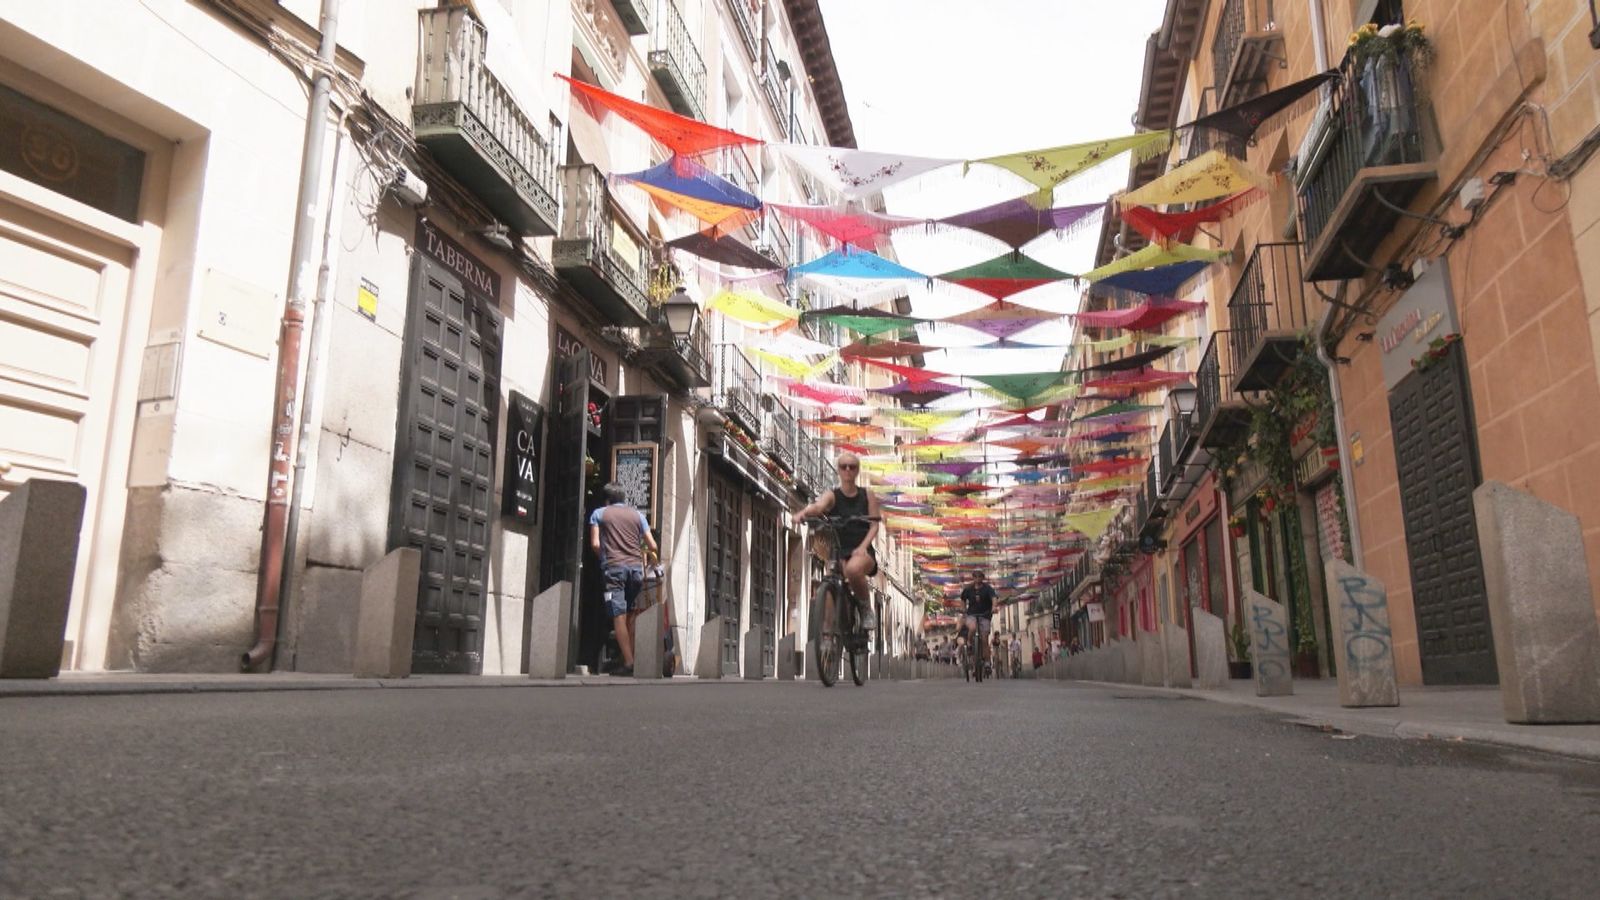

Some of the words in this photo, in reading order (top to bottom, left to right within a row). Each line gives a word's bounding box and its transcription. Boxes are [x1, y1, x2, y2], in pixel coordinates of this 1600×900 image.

[425, 229, 494, 297] TABERNA
[517, 430, 536, 457] CA
[517, 455, 535, 483] VA
